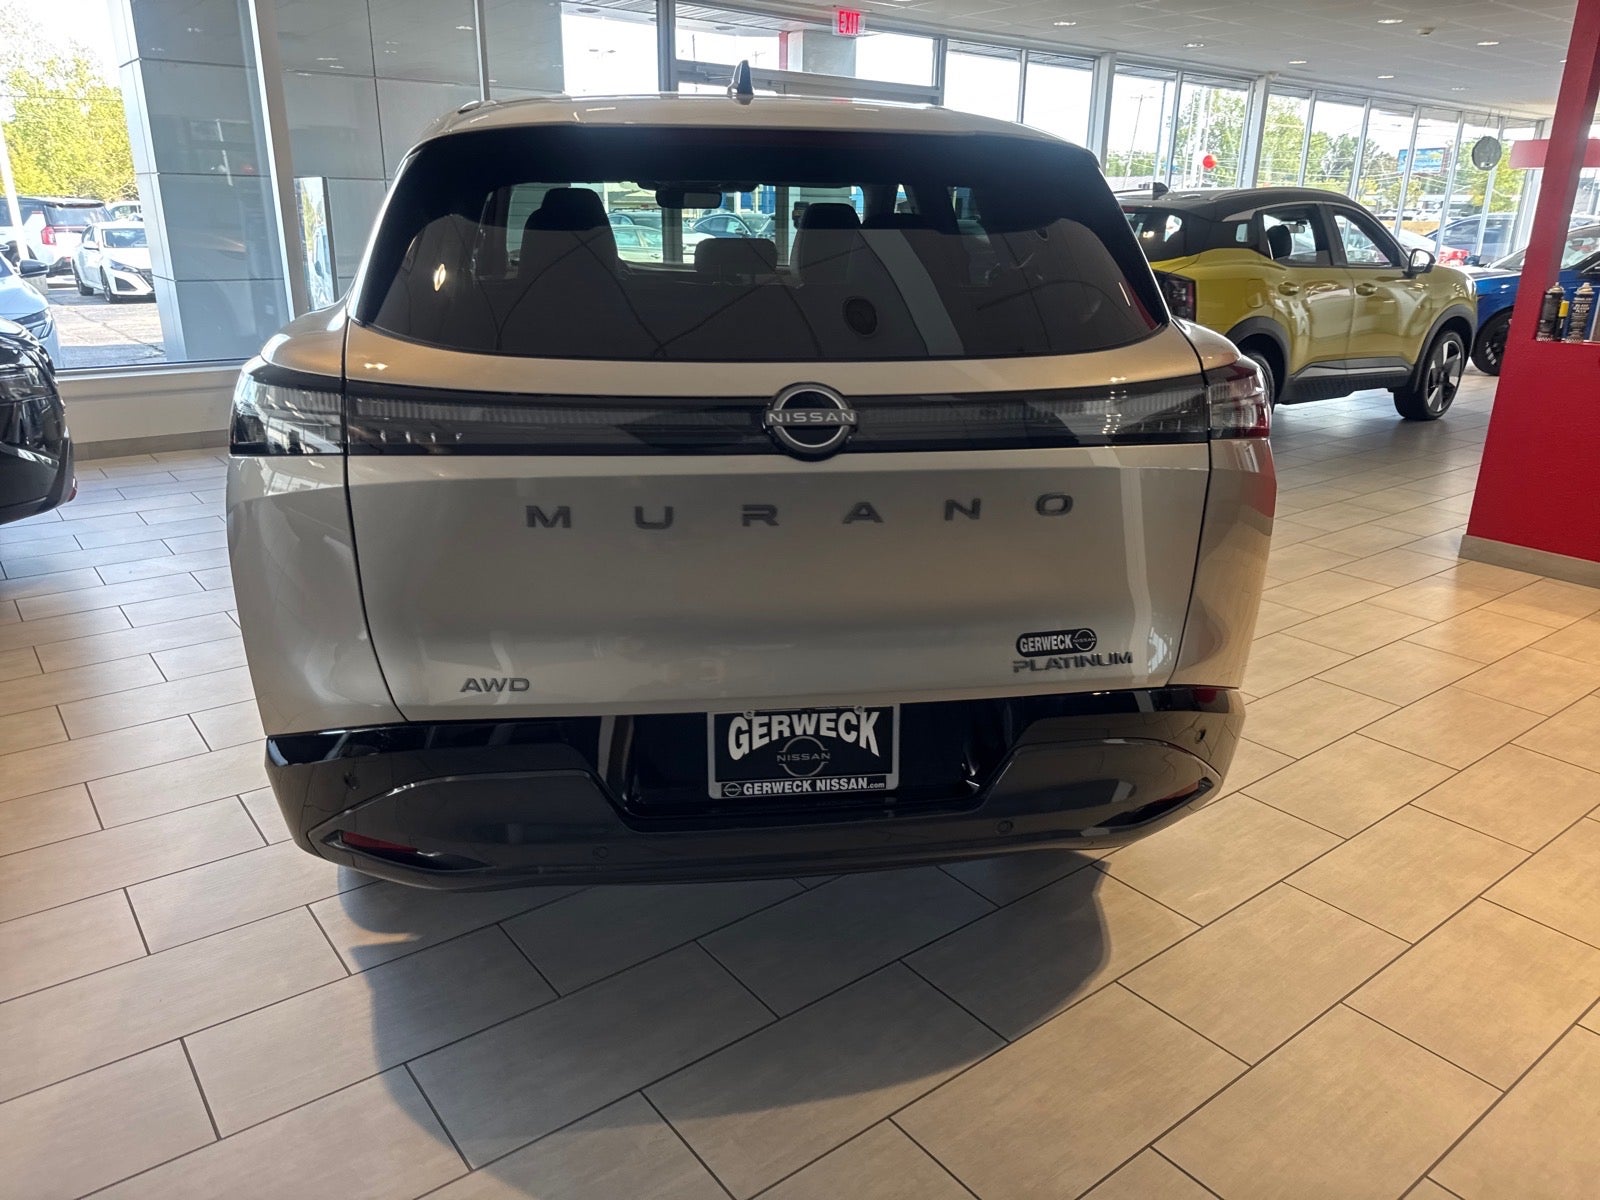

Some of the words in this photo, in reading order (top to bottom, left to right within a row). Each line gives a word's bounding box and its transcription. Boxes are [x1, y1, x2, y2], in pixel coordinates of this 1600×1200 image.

[838, 11, 860, 35] EXIT
[768, 412, 855, 423] NISSAN
[526, 493, 1074, 530] MURANO
[1020, 634, 1073, 653] GERWECK
[1013, 651, 1133, 673] PLATINUM
[460, 678, 530, 692] AWD
[728, 711, 880, 760] GERWECK
[776, 752, 831, 762] NISSAN
[743, 780, 813, 796] GERWECK
